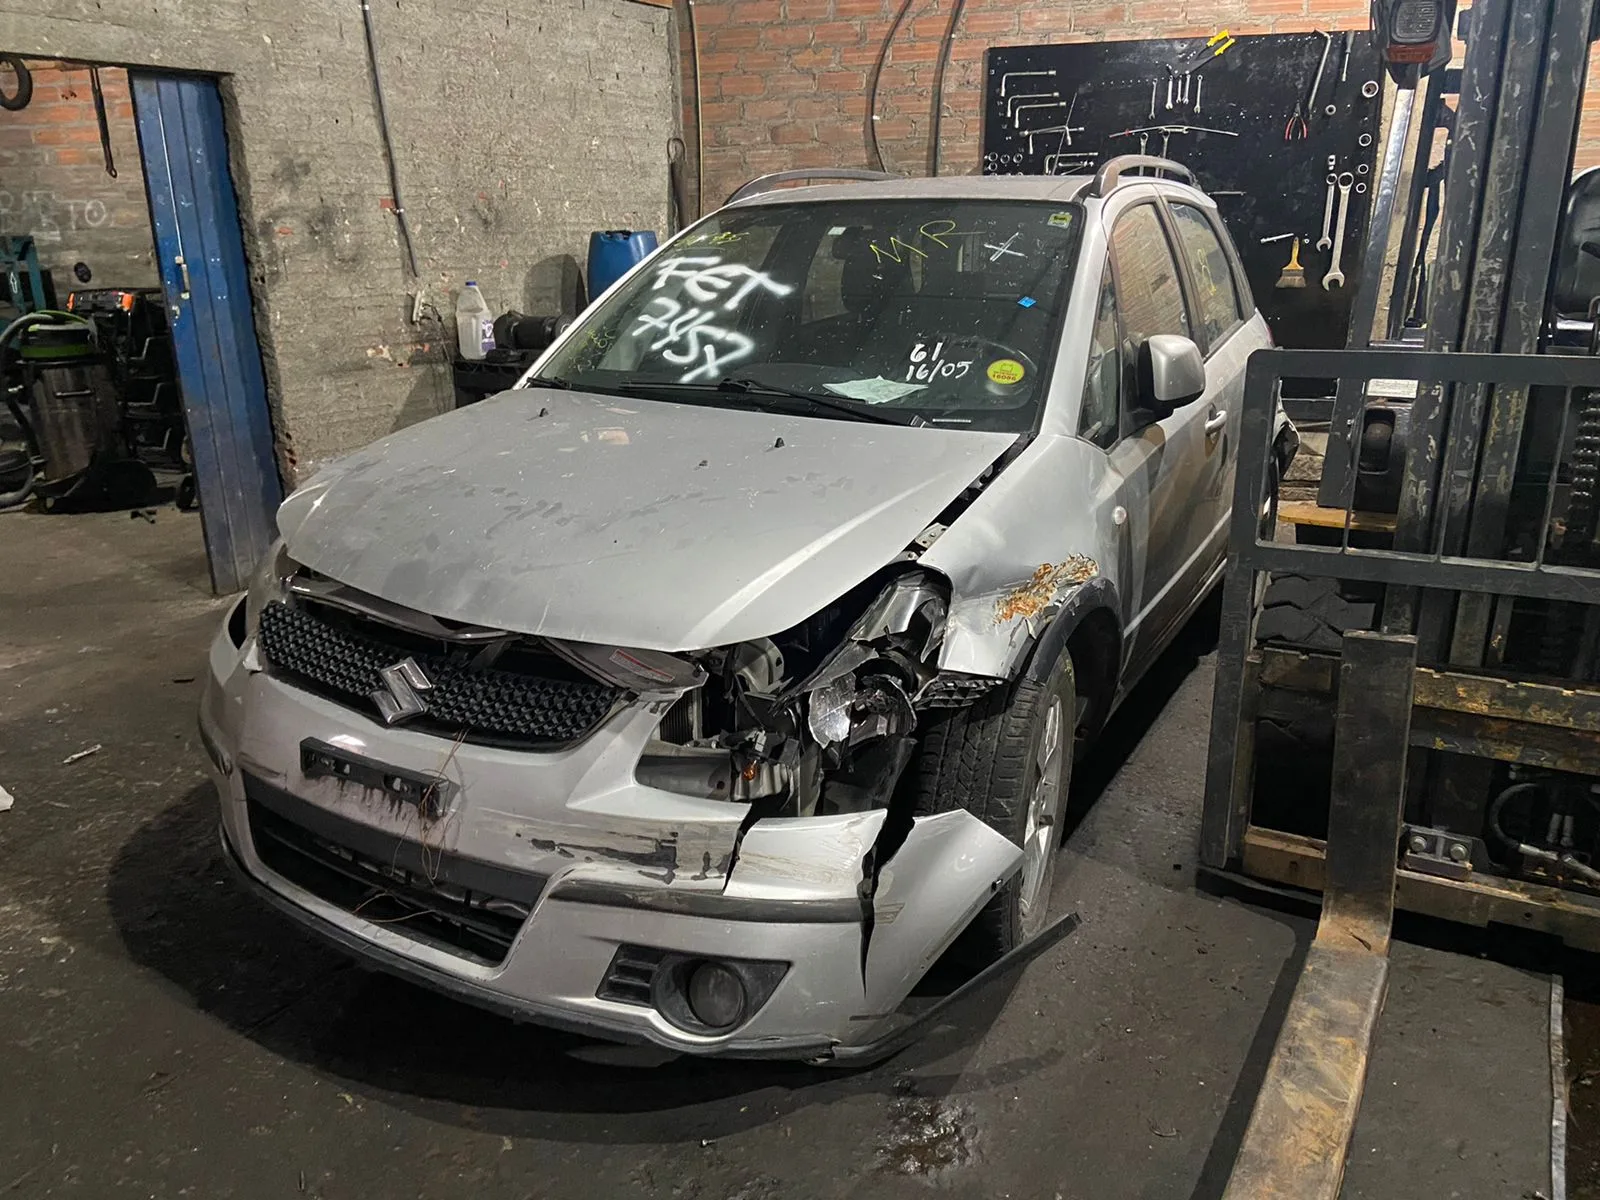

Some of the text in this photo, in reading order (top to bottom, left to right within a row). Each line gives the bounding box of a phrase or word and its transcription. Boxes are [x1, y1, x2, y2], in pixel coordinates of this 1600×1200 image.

[652, 256, 794, 310] FET
[910, 342, 944, 363] 61
[906, 359, 974, 384] 16/05
